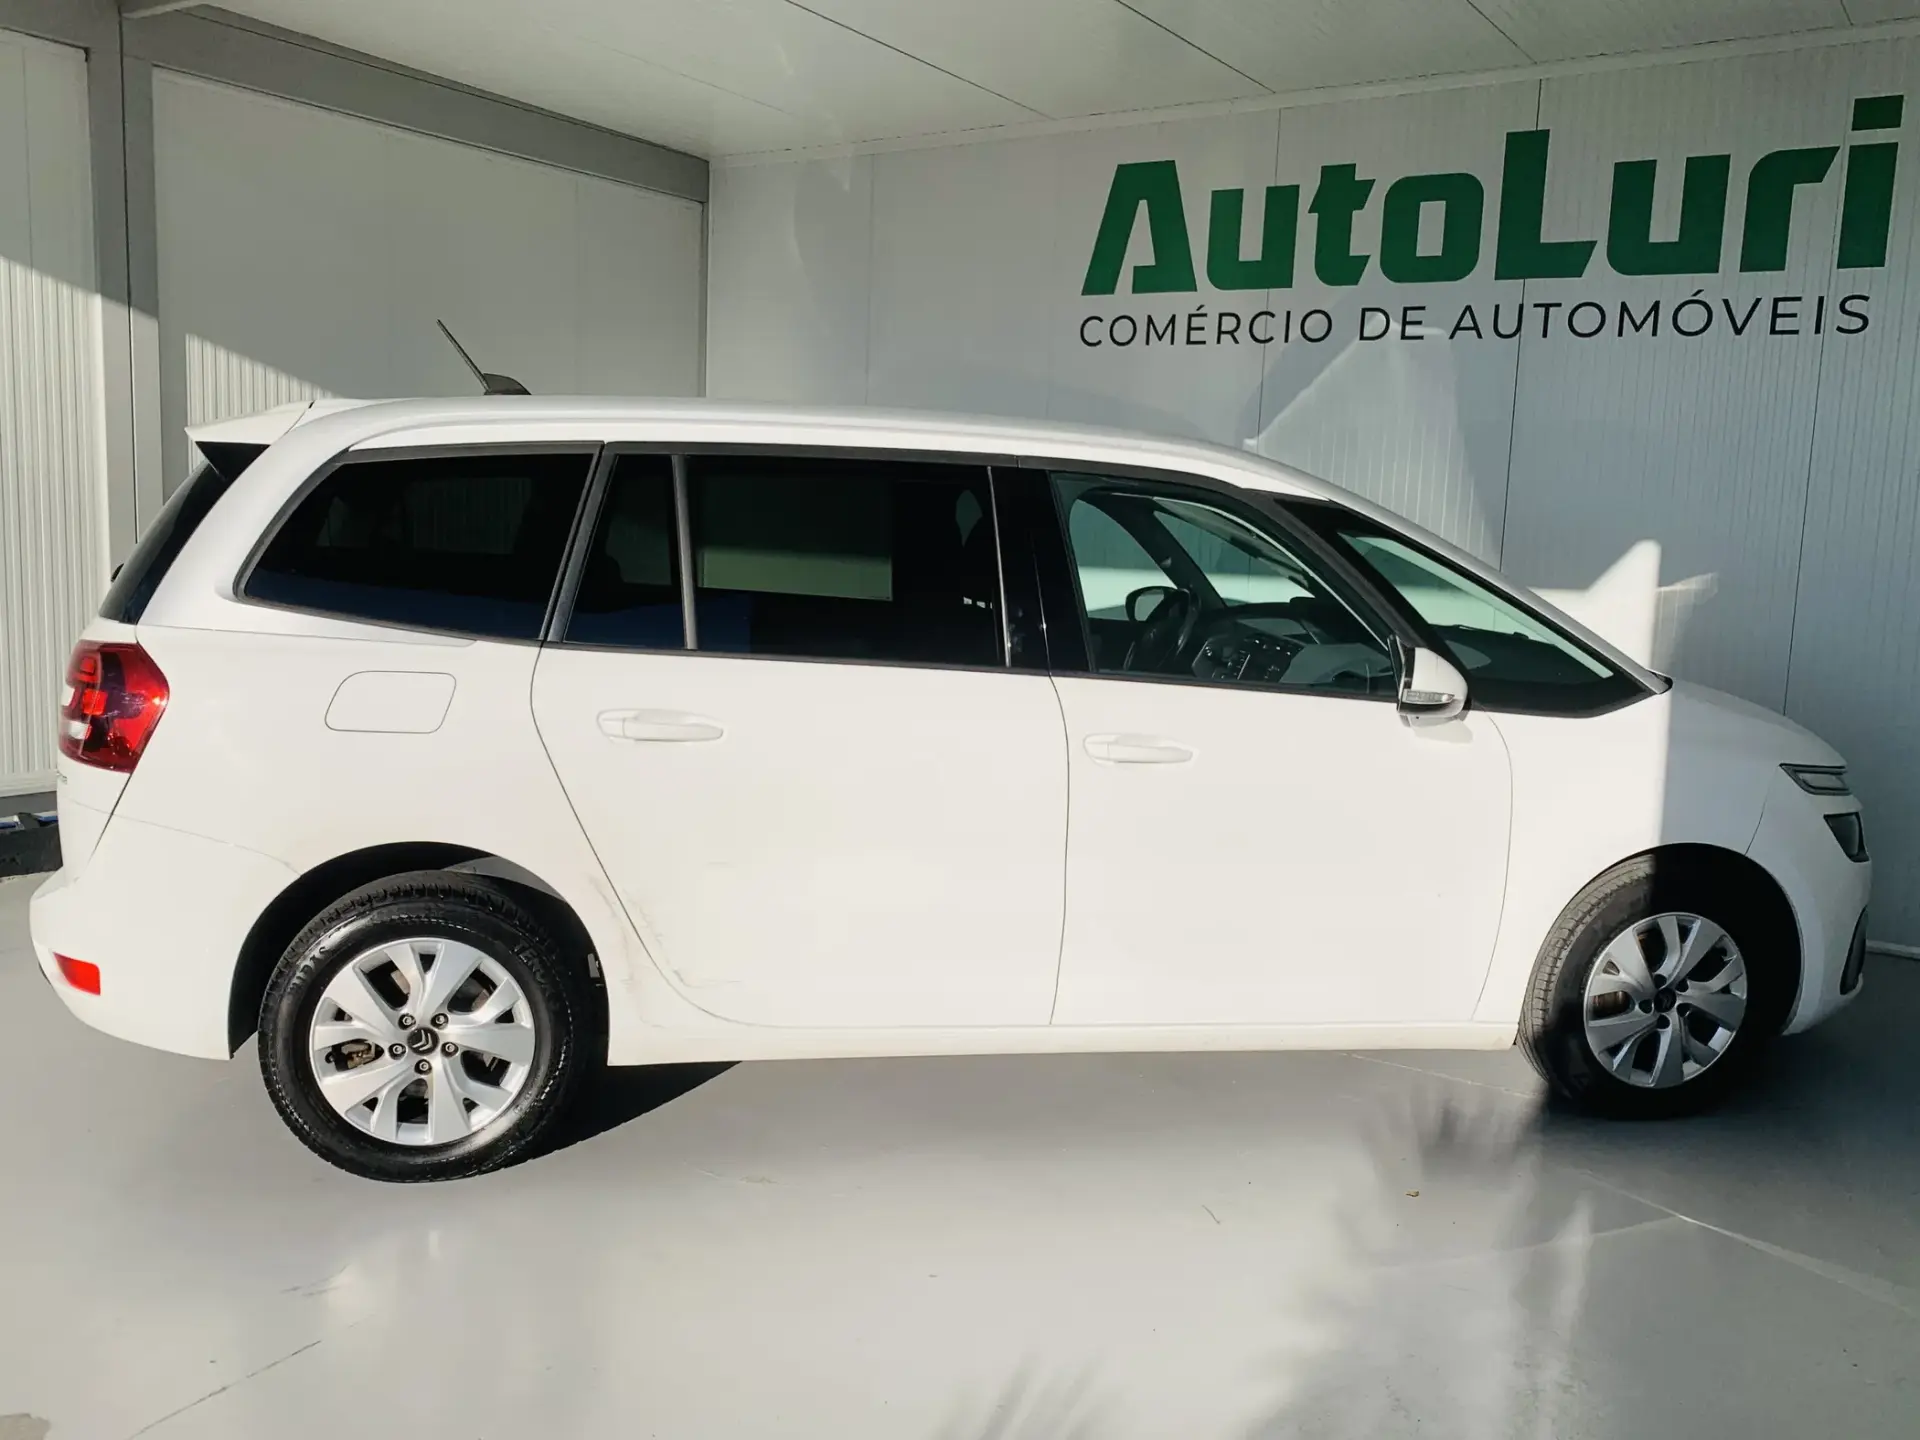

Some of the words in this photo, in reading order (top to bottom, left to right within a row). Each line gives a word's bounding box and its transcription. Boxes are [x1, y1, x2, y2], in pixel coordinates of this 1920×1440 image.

[1081, 95, 1904, 295] AutoLuri
[1079, 305, 1333, 348] COMÉRCIO
[1358, 306, 1427, 342] DE
[1448, 289, 1871, 341] AUTOMÓVEIS
